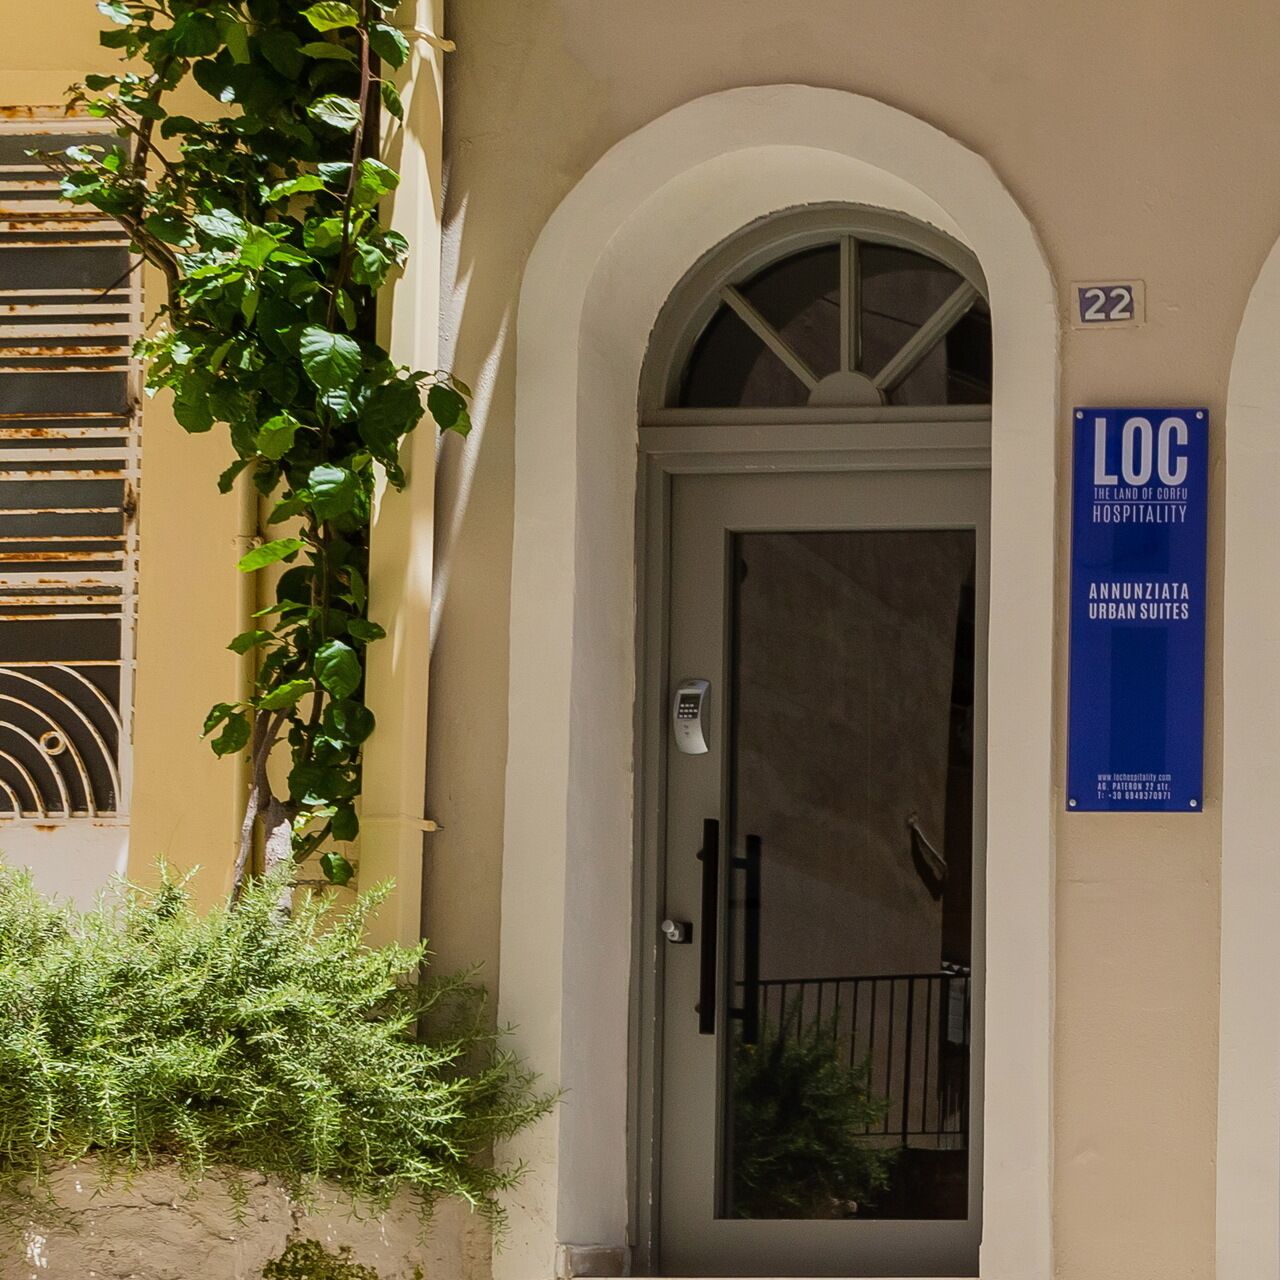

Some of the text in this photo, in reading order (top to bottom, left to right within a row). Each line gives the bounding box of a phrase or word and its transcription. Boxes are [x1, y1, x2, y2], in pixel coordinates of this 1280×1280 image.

[1084, 287, 1131, 320] 22
[1094, 416, 1188, 486] LOC
[1094, 487, 1188, 500] THE LAND OF CORFU
[1093, 504, 1187, 523] HOSPITALITY
[1089, 582, 1190, 600] ANNUNZIATA
[1089, 602, 1189, 620] URBAN SUITES
